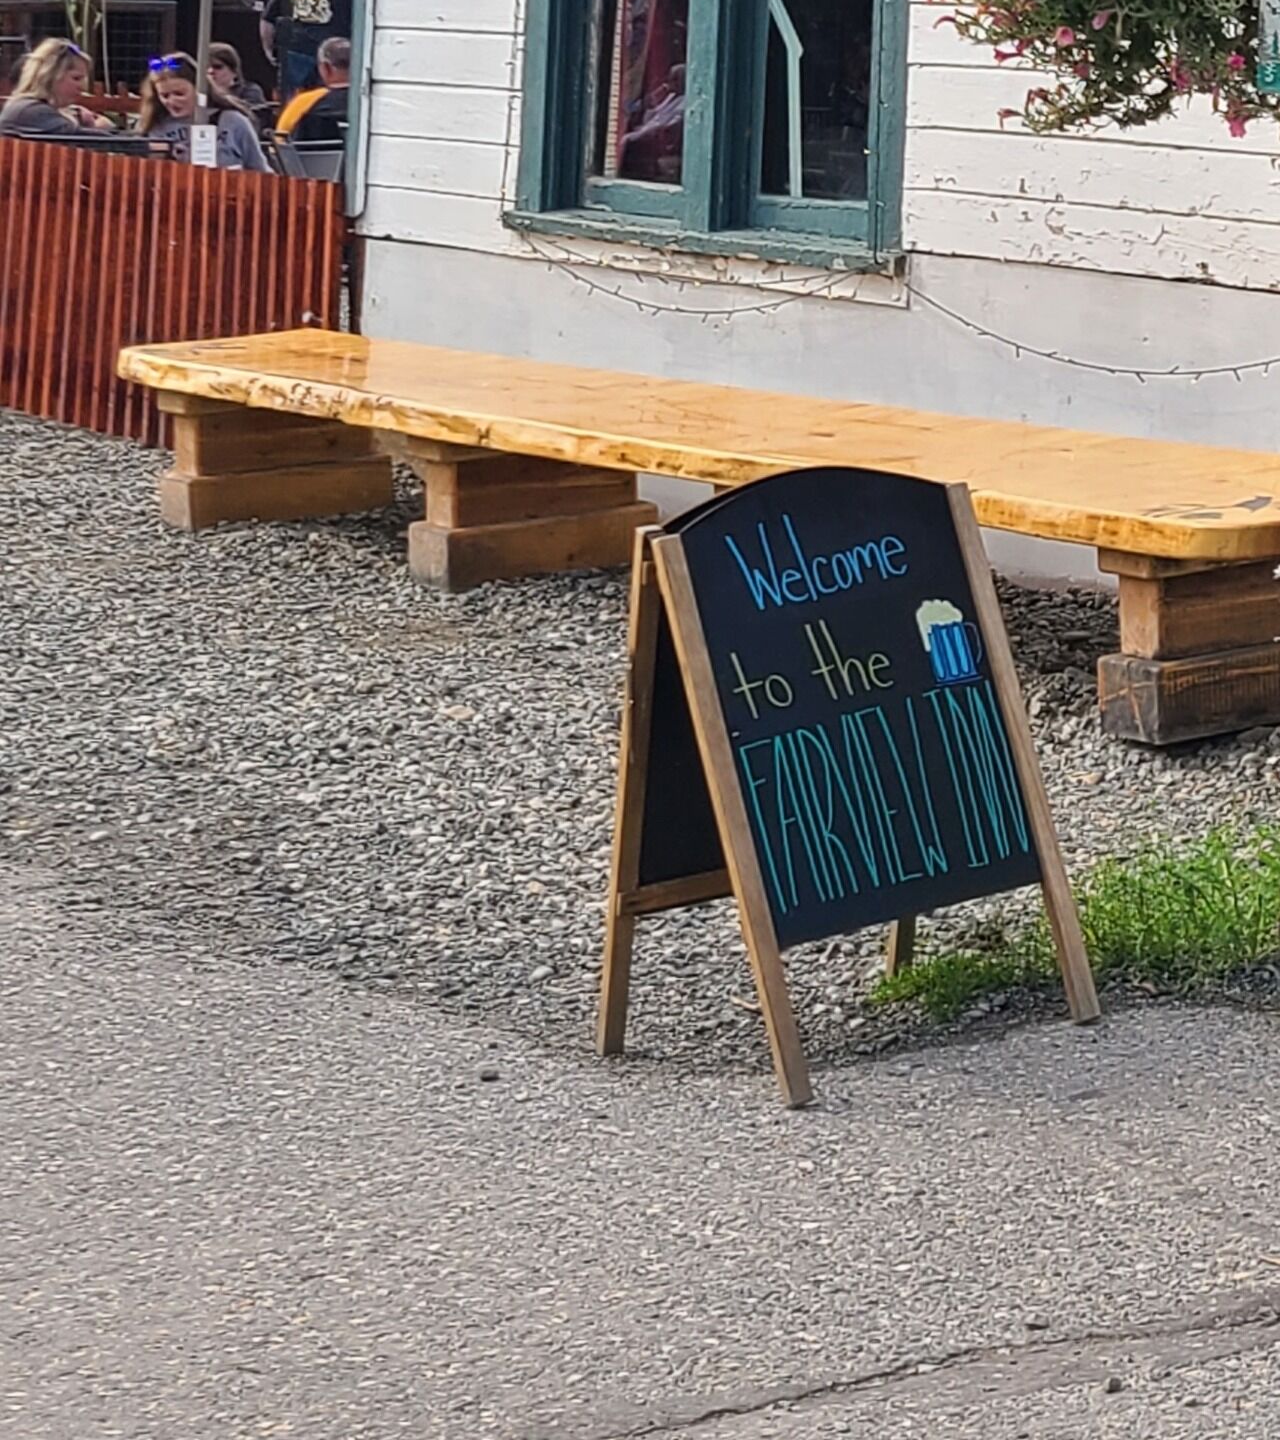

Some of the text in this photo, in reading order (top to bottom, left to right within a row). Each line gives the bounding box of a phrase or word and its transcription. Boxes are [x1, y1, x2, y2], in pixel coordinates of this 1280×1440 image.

[725, 514, 909, 611] Welcome
[729, 619, 895, 720] to the
[739, 679, 1029, 914] FAIRVIEW INN
